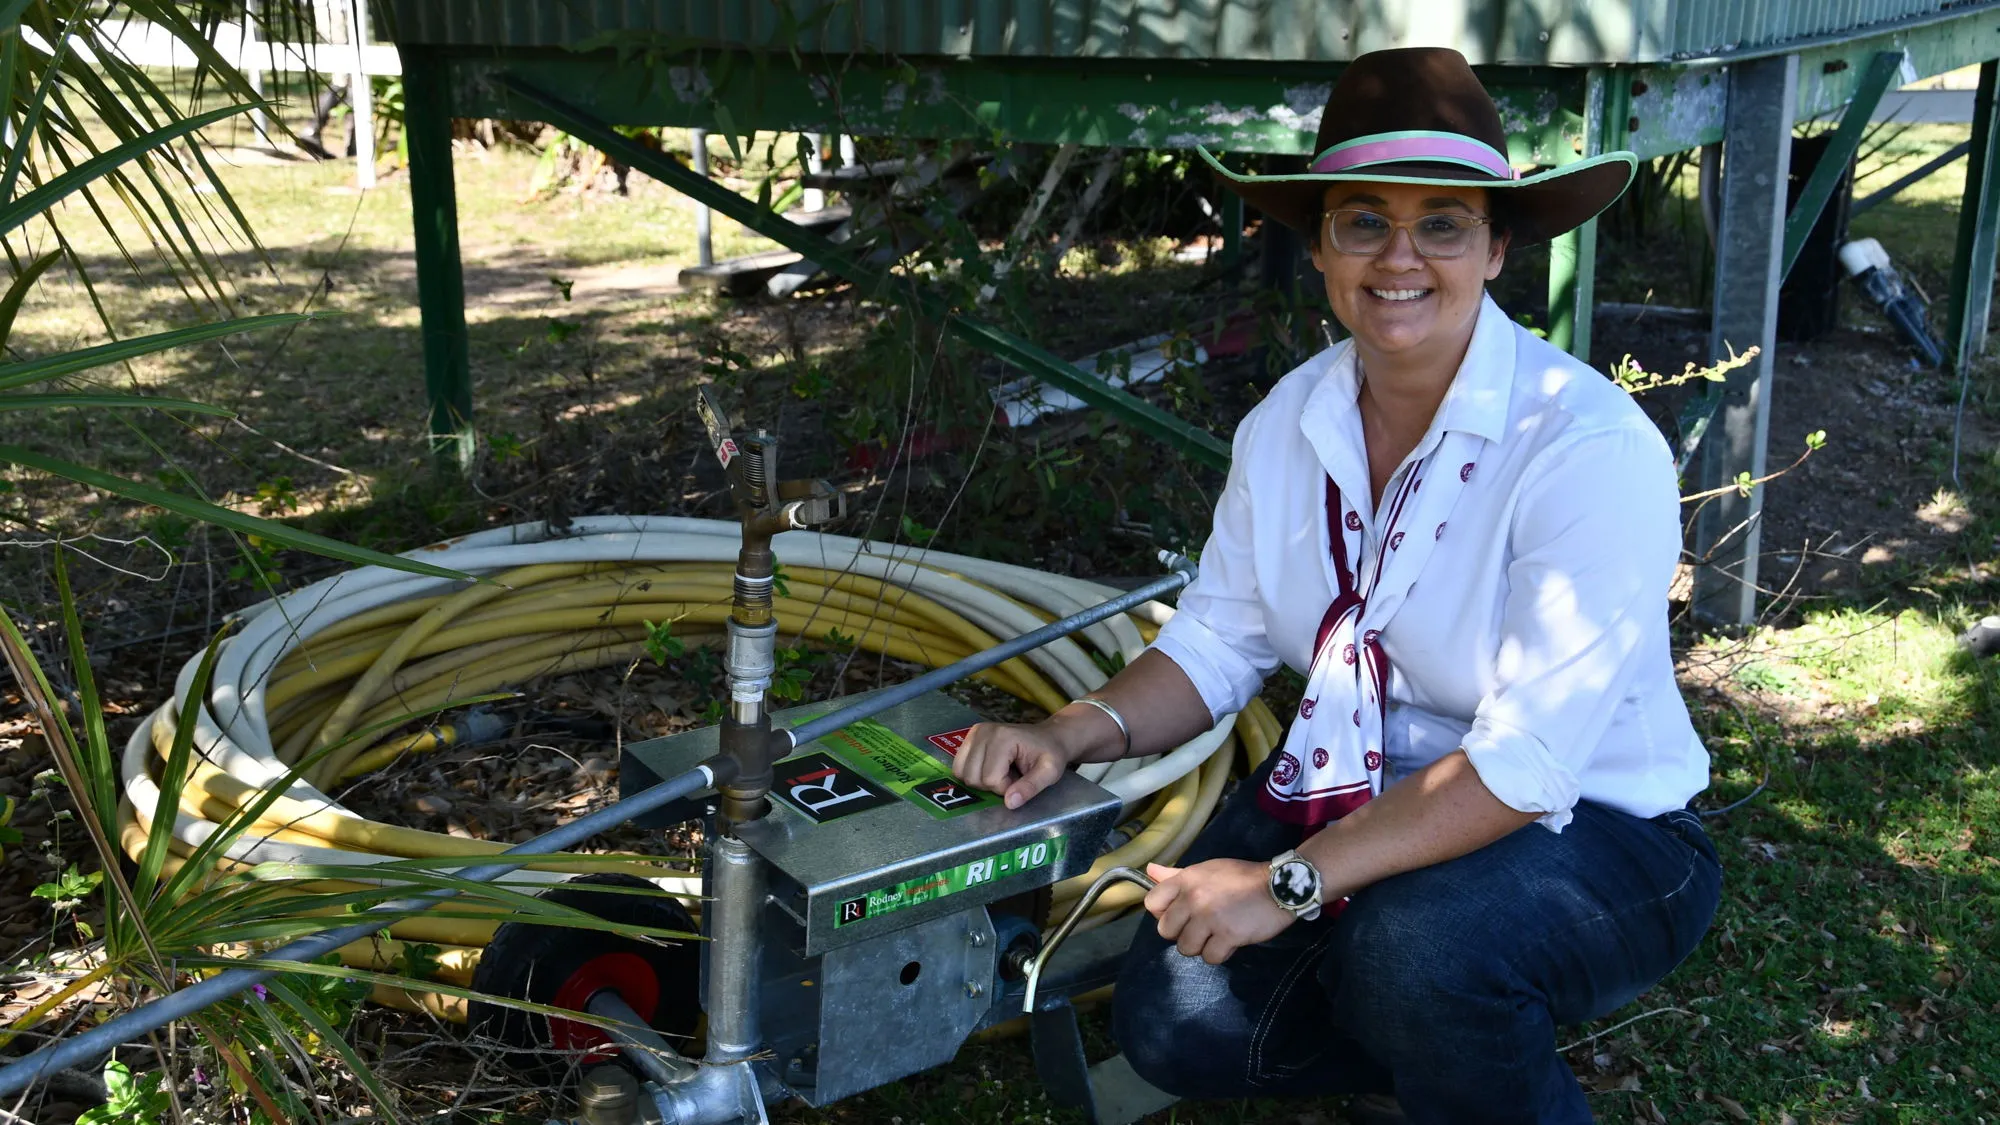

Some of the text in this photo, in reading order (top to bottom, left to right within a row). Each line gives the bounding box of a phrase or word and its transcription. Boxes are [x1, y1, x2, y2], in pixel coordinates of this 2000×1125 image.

[870, 755, 917, 784] Rodney
[966, 858, 995, 887] RI
[1018, 843, 1047, 870] 10
[869, 891, 904, 907] Rodney
